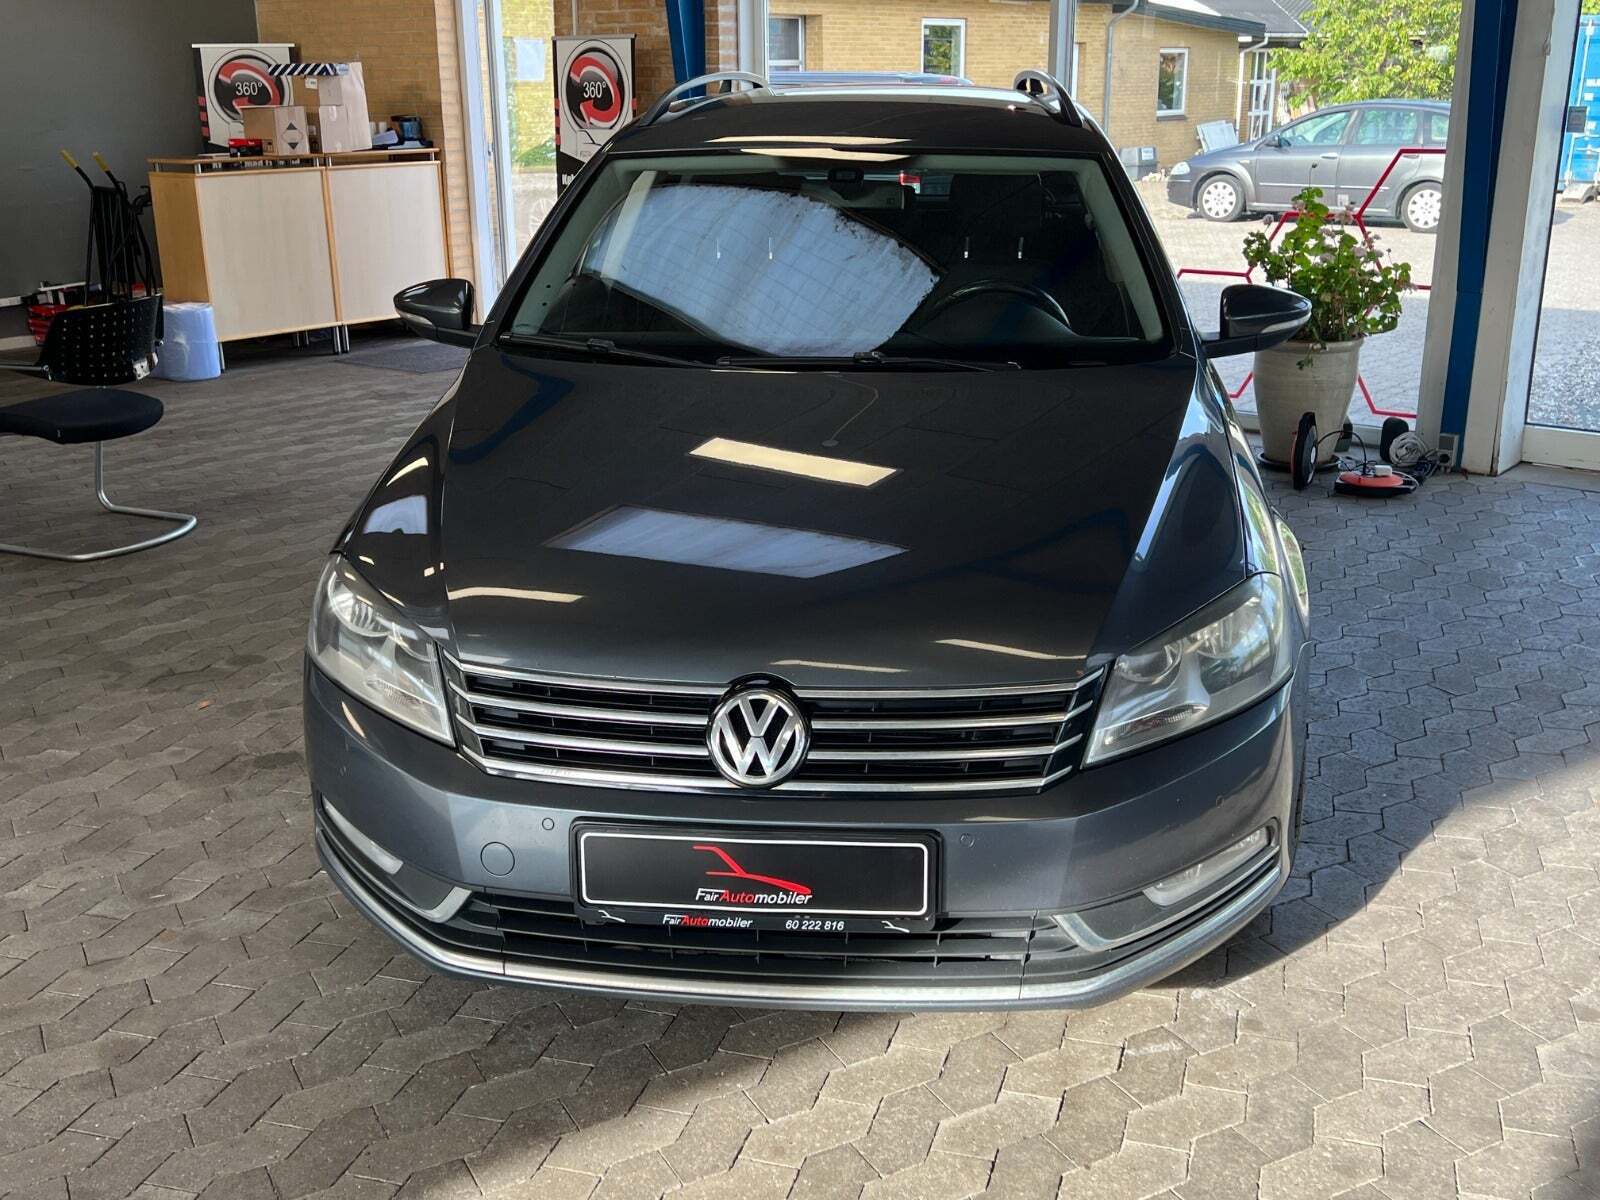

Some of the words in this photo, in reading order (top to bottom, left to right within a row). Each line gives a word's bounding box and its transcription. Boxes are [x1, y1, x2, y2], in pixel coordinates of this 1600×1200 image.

[235, 81, 263, 96] 360°
[583, 81, 607, 98] 360°
[711, 691, 802, 780] VW
[695, 888, 812, 905] FairAutomobiler
[662, 914, 753, 928] FairAutomobiler
[785, 919, 800, 930] 60
[801, 920, 821, 930] 222
[824, 921, 845, 931] 816
